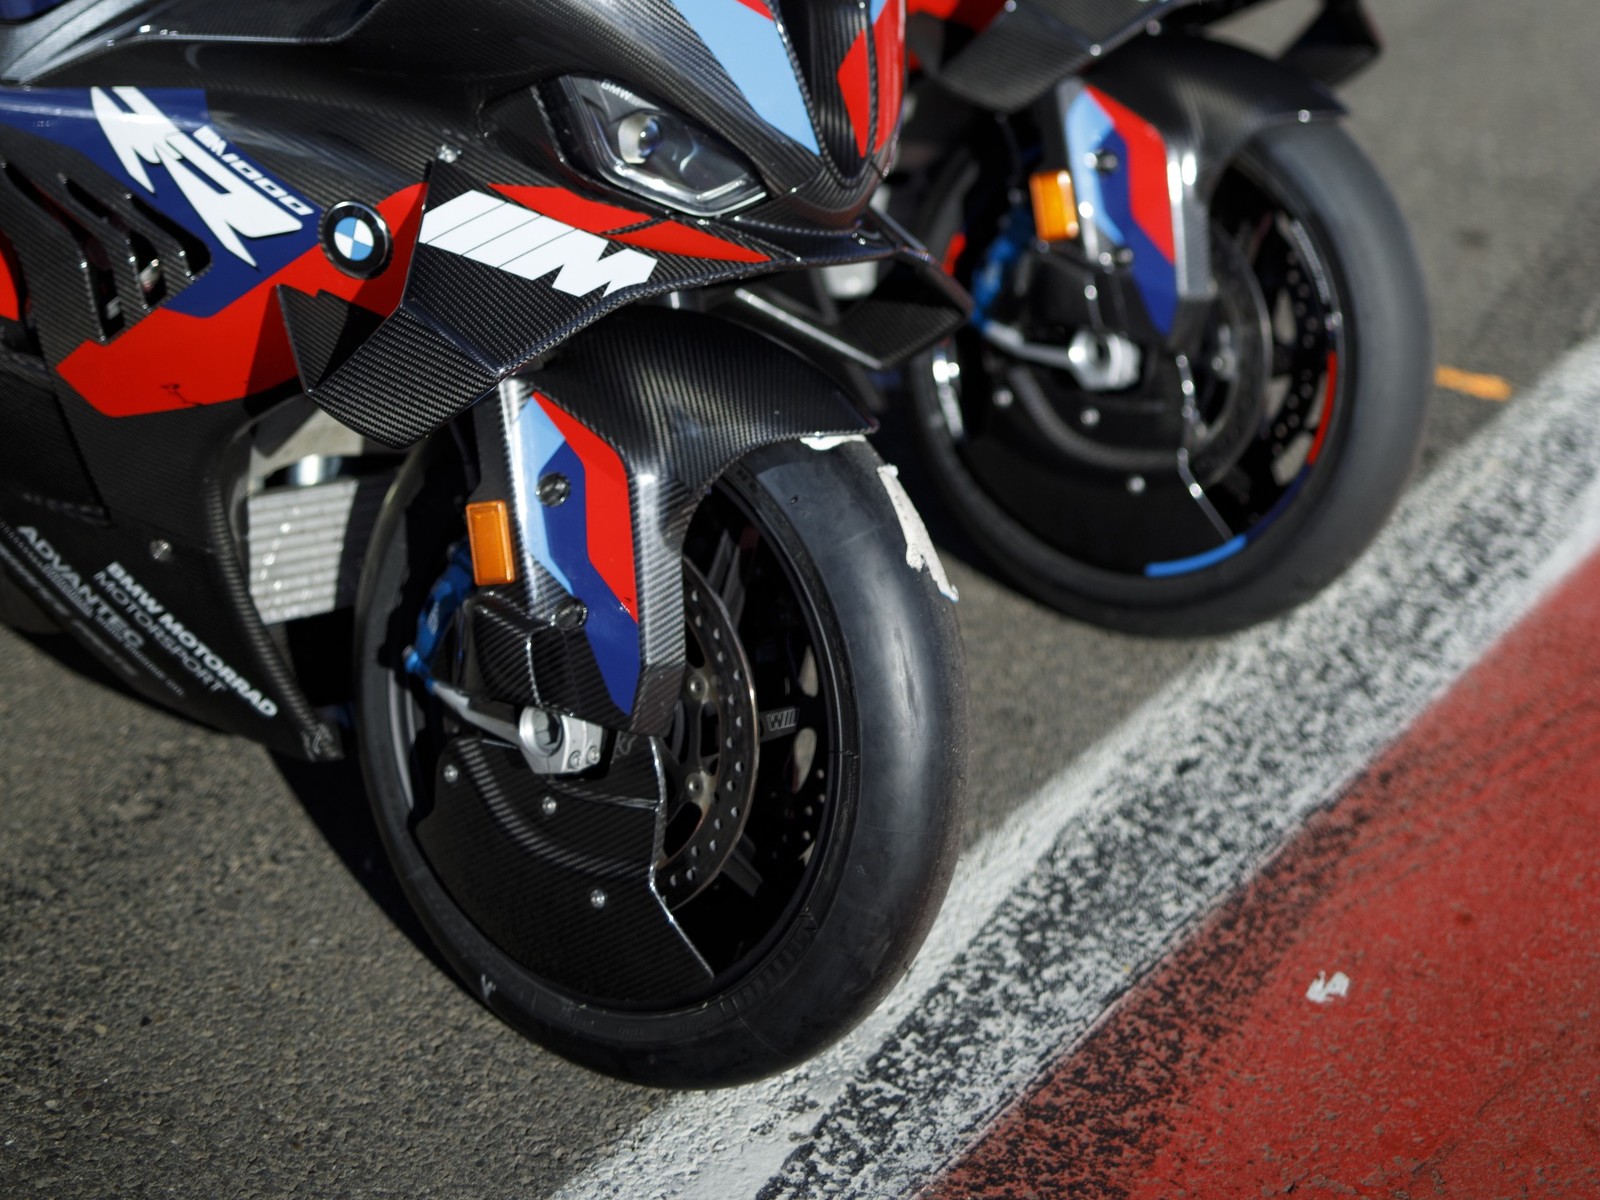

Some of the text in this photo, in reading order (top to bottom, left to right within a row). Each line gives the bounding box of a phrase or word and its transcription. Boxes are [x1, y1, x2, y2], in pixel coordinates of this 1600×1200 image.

[17, 525, 145, 650] ADVANTEC
[92, 569, 228, 693] MOTORSPORT
[105, 560, 165, 617] BMW
[158, 611, 279, 719] MOTORRAD
